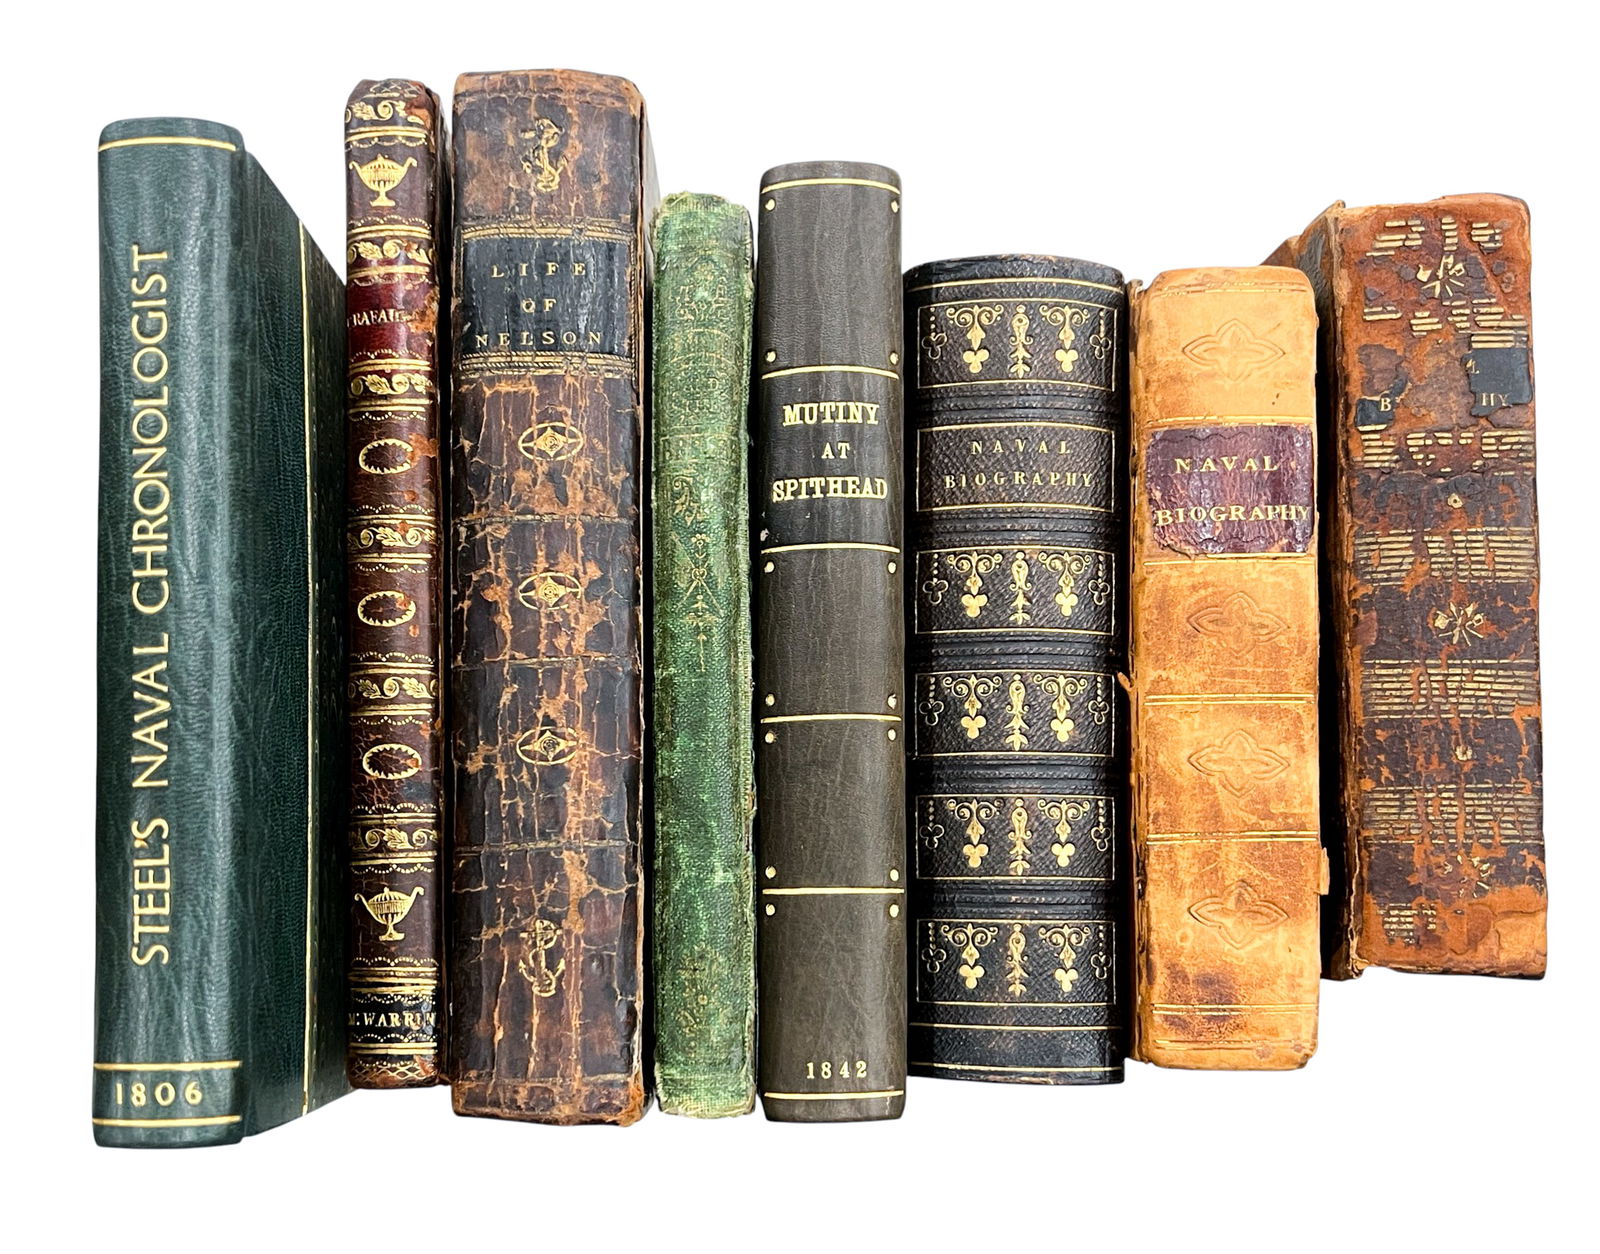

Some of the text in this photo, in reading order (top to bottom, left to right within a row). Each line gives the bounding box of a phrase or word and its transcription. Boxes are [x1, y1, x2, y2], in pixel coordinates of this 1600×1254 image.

[491, 262, 586, 278] LIFE
[521, 297, 558, 313] OF
[475, 331, 602, 348] NELSON
[782, 401, 880, 427] MUTINY
[821, 442, 850, 459] AT
[970, 438, 1070, 455] NAVAL
[1174, 455, 1279, 474] NAVAL
[772, 475, 888, 503] SPITHEAD
[944, 471, 1093, 489] BIOGRAPHY
[1155, 504, 1311, 527] BIOGRAPHY
[130, 244, 172, 965] STEEL'S NAVAL CHRONOLOGIST
[806, 1060, 867, 1080] 1842
[115, 1081, 203, 1107] 1806
